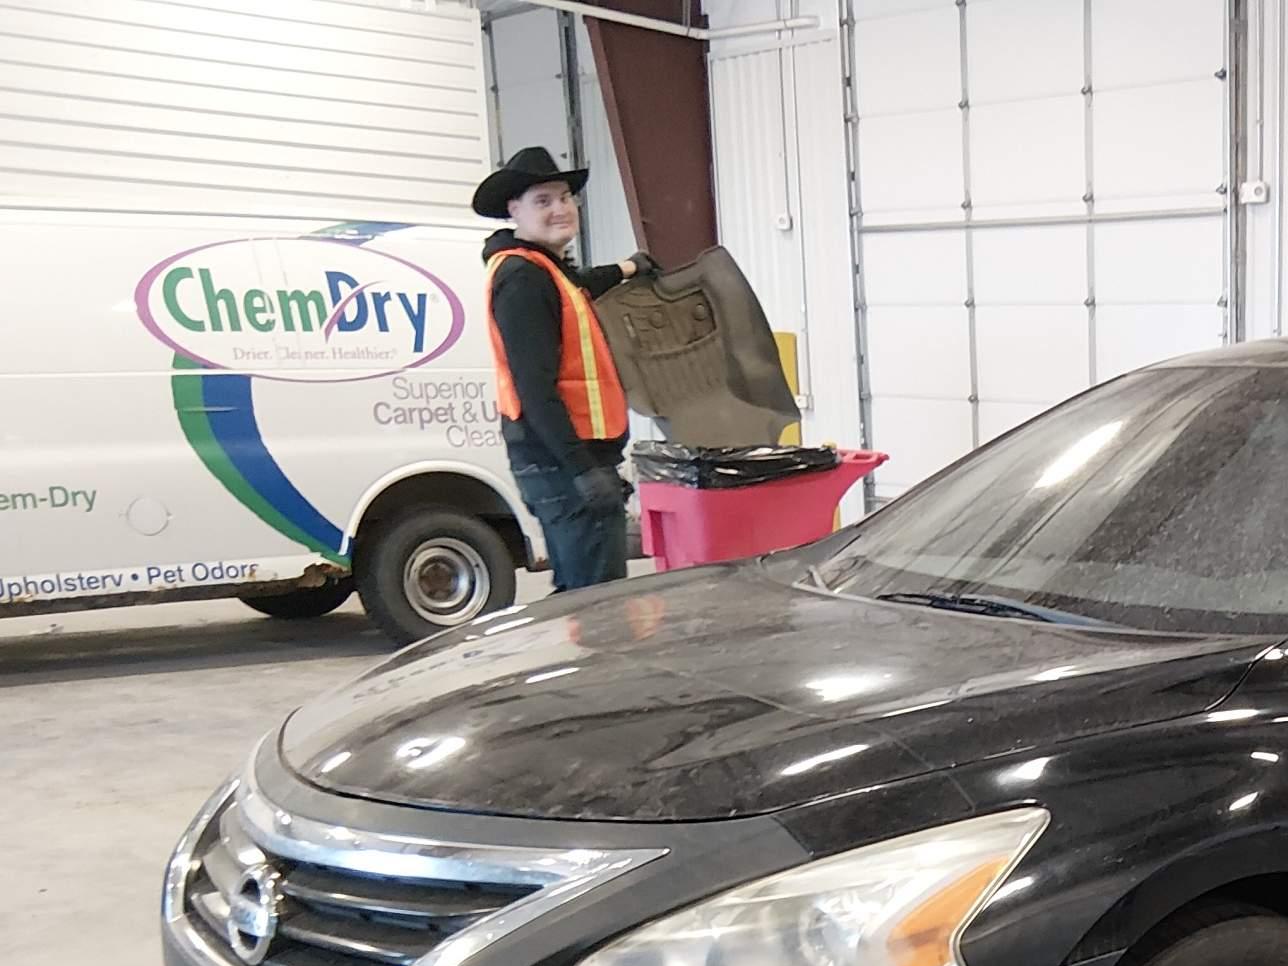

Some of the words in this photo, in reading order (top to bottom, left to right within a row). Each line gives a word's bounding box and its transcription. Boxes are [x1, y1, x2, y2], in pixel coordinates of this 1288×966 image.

[162, 266, 428, 353] ChemDry
[392, 376, 487, 405] Superior
[373, 401, 457, 430] Carpet
[462, 401, 479, 423] &
[147, 565, 185, 585] Pet
